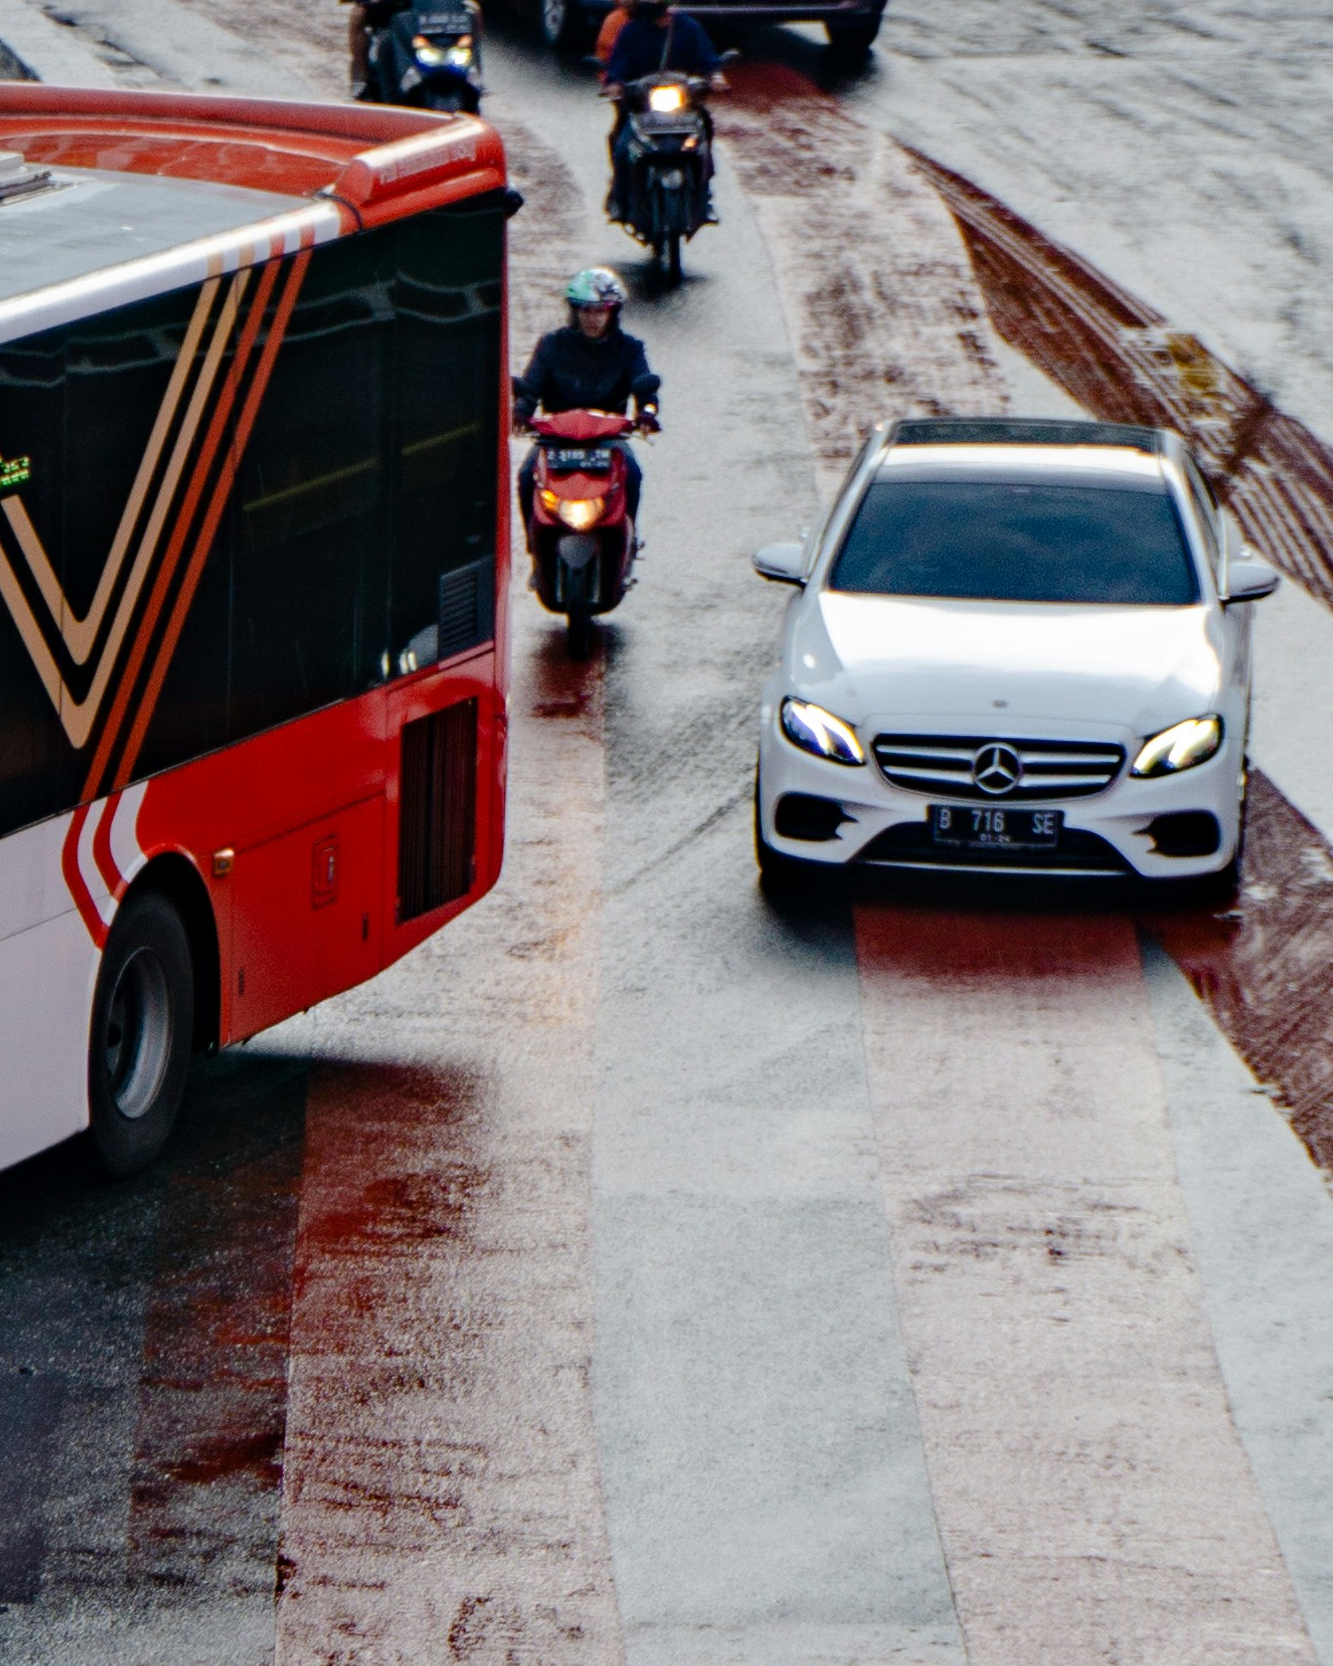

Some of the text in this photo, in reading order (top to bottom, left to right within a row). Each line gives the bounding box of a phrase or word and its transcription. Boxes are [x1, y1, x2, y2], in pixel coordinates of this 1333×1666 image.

[939, 808, 1054, 835] B 716 SE
